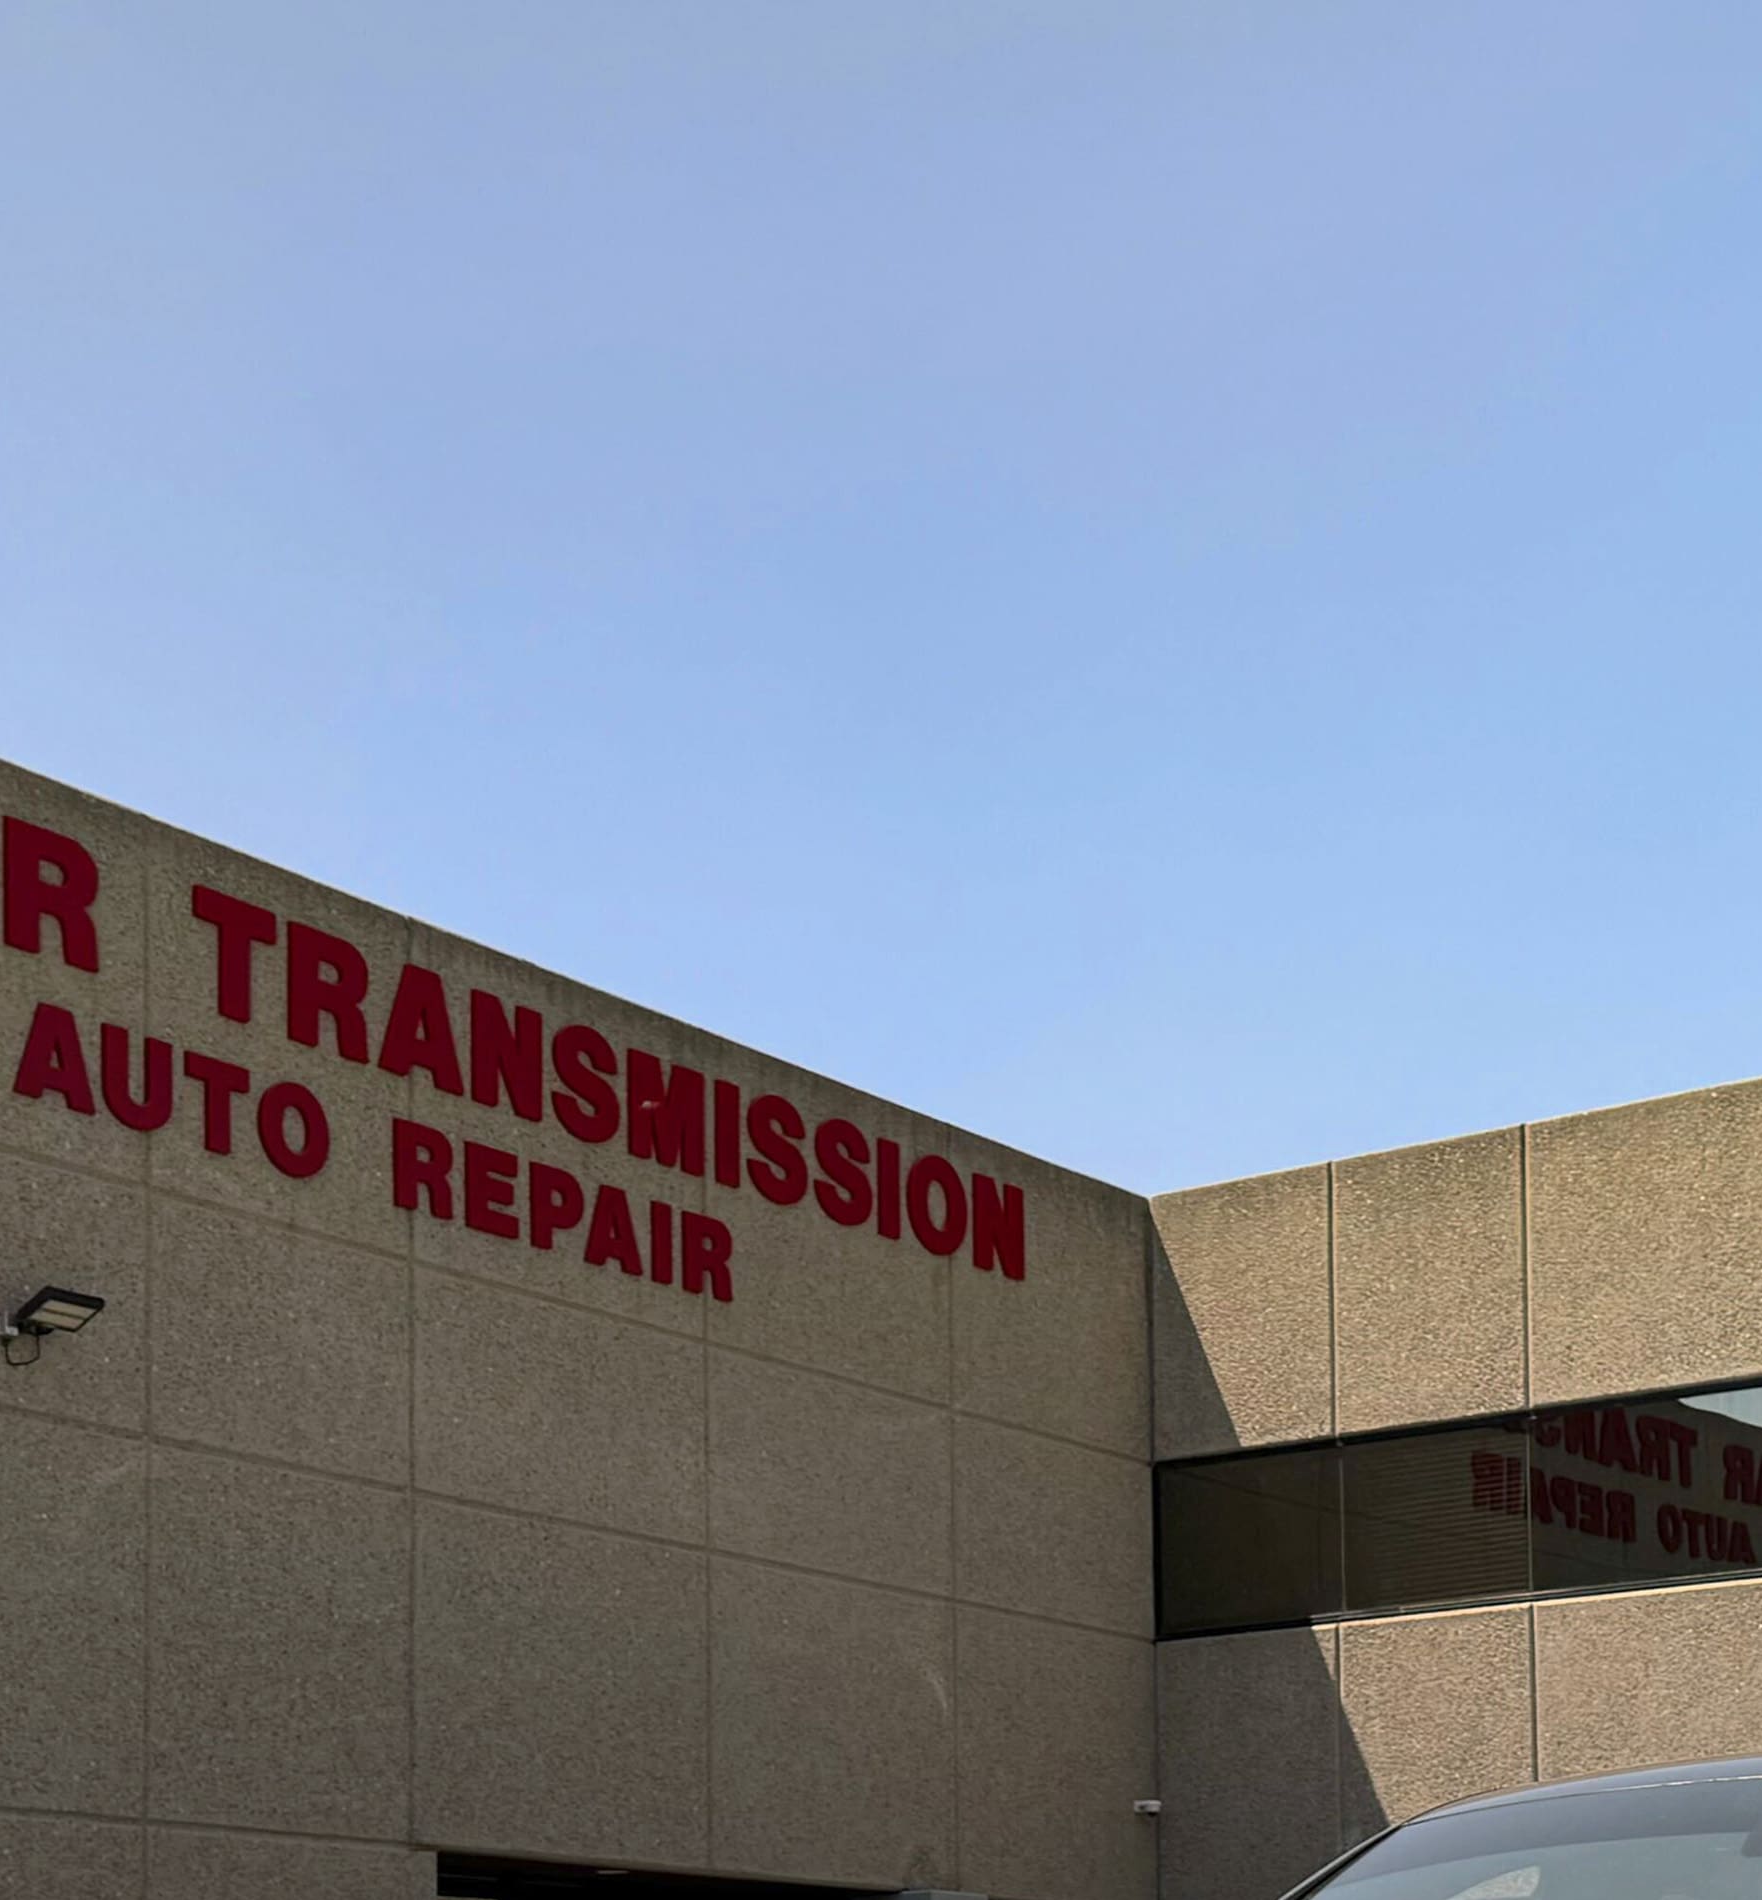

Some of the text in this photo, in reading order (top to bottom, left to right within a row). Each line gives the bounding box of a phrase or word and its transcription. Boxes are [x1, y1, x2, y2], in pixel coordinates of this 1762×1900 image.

[12, 1003, 330, 1179] AUTO
[392, 1117, 734, 1302] REPAIR
[191, 883, 1026, 1281] TRANSMISSION
